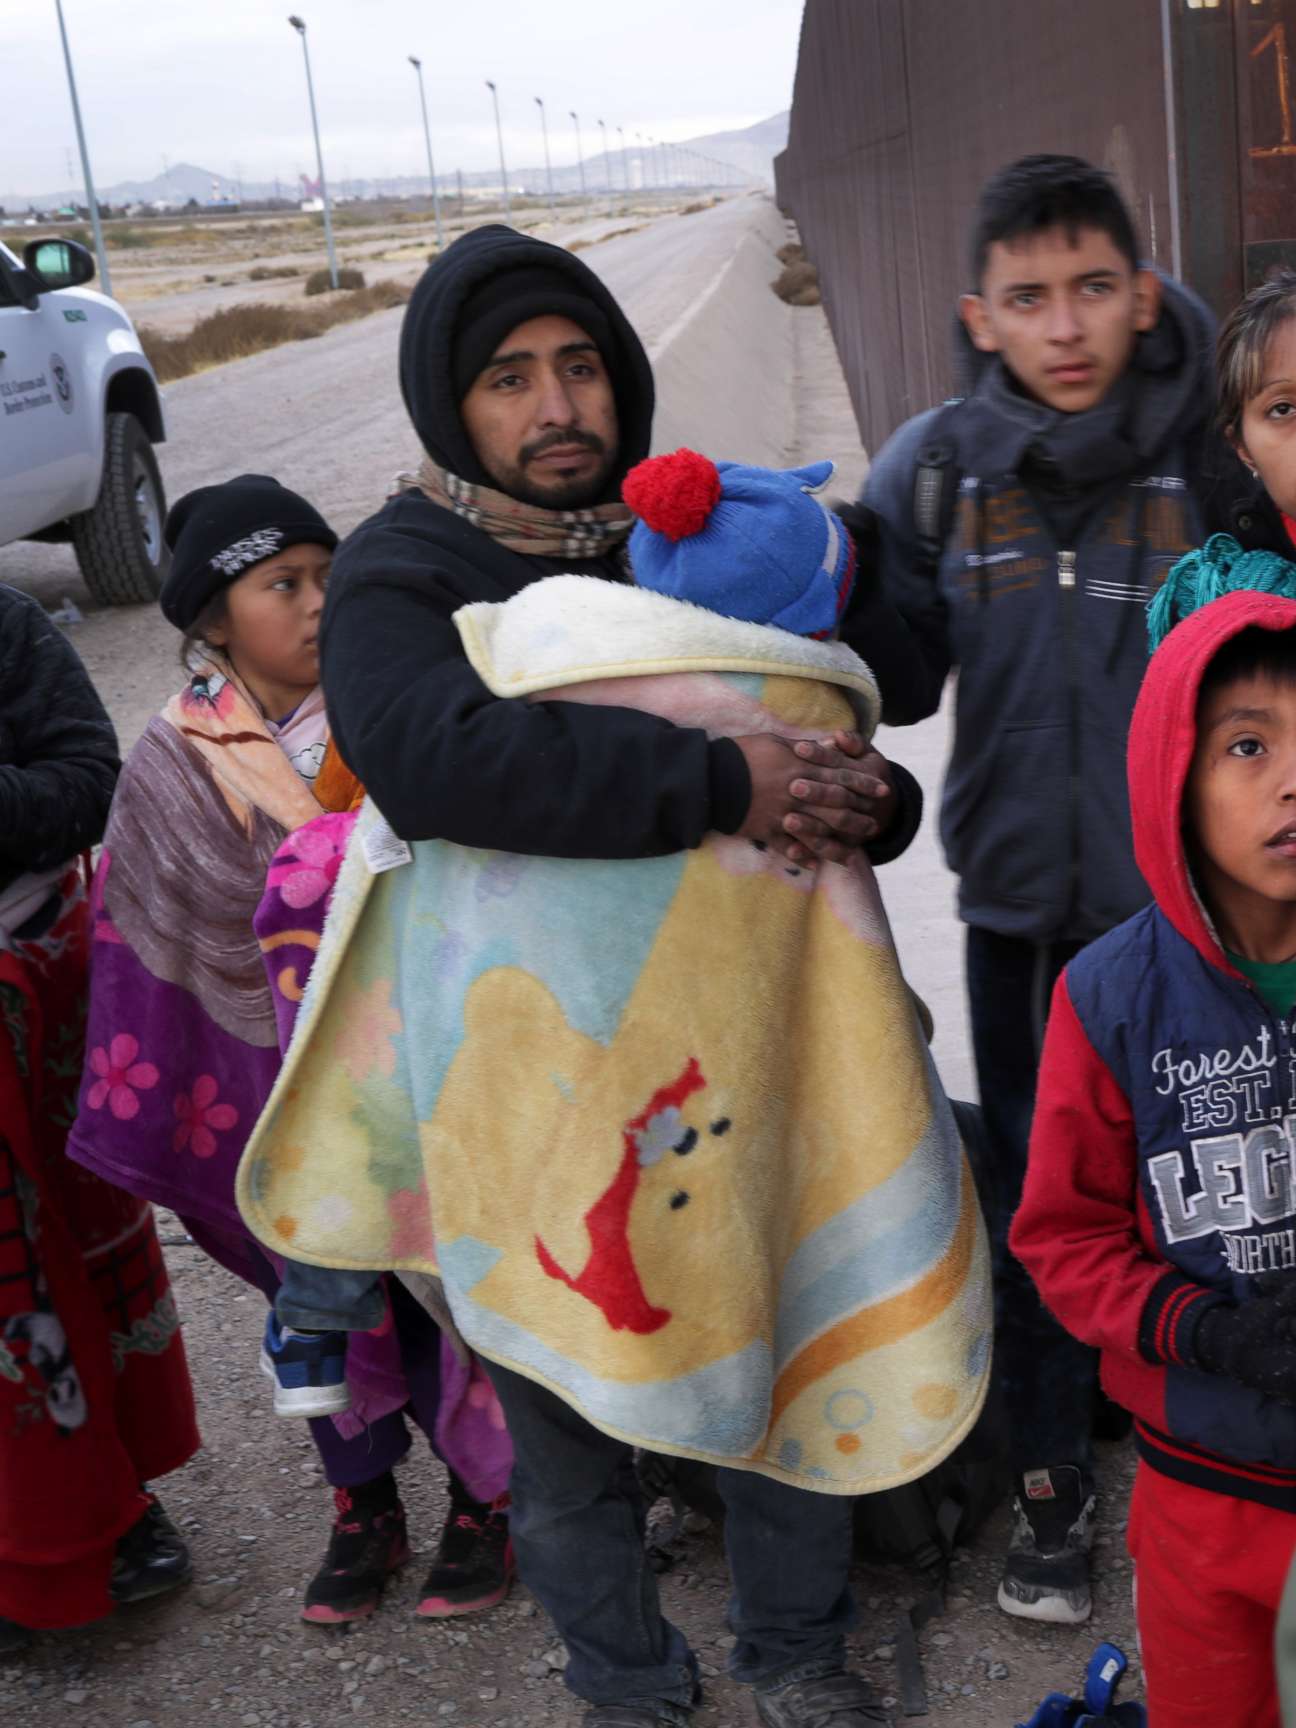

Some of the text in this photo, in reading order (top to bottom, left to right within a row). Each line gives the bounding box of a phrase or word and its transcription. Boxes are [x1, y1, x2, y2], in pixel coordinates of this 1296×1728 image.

[1151, 1024, 1277, 1095] Forest
[1178, 1070, 1283, 1133] EST.
[1219, 1229, 1296, 1274] NORTH
